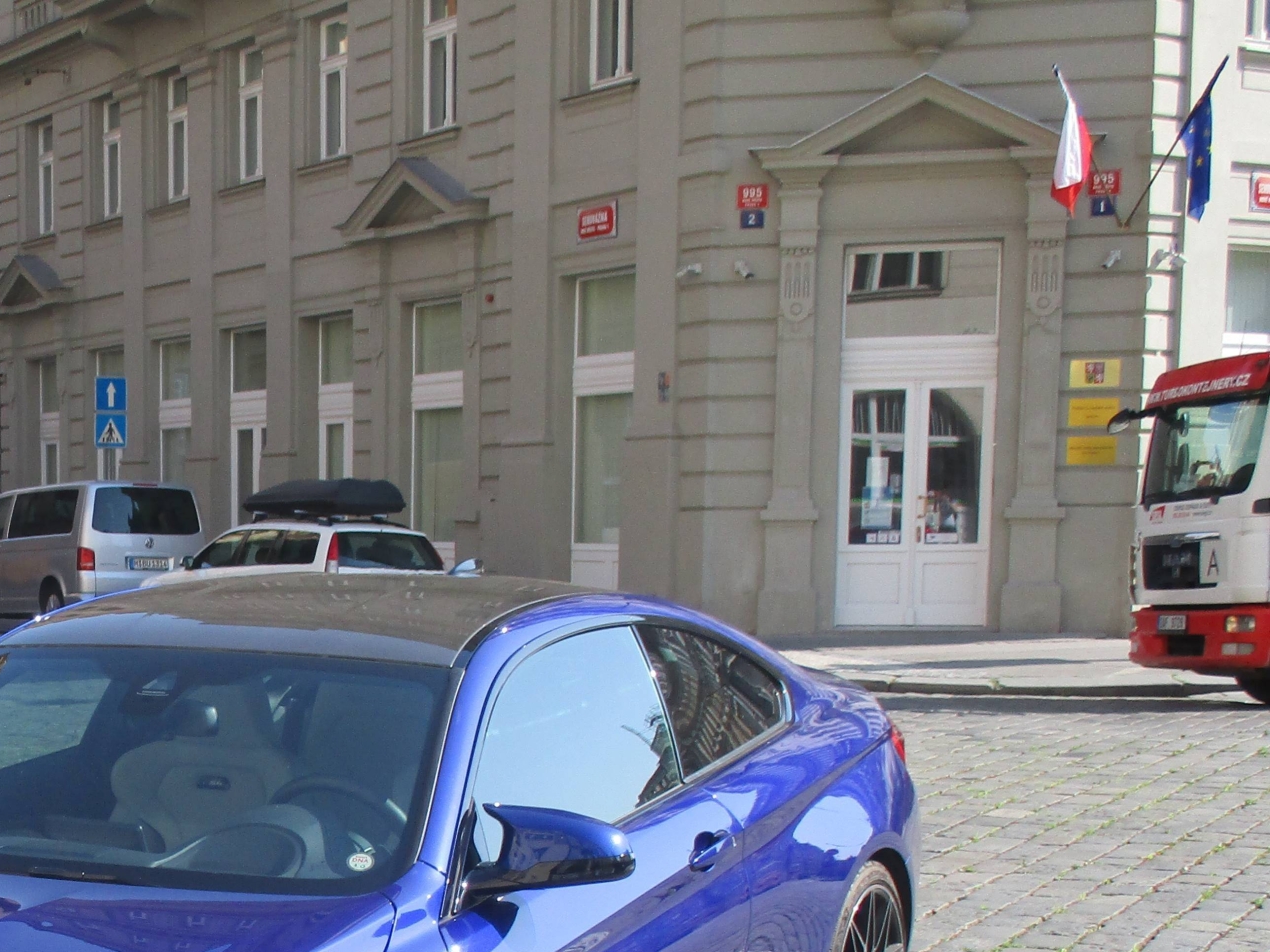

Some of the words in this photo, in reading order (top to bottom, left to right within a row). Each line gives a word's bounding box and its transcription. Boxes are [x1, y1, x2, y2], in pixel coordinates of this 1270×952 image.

[1093, 173, 1114, 185] 995
[742, 187, 762, 198] 995
[1100, 200, 1105, 212] 1
[748, 213, 756, 225] 2
[1207, 548, 1220, 577] A
